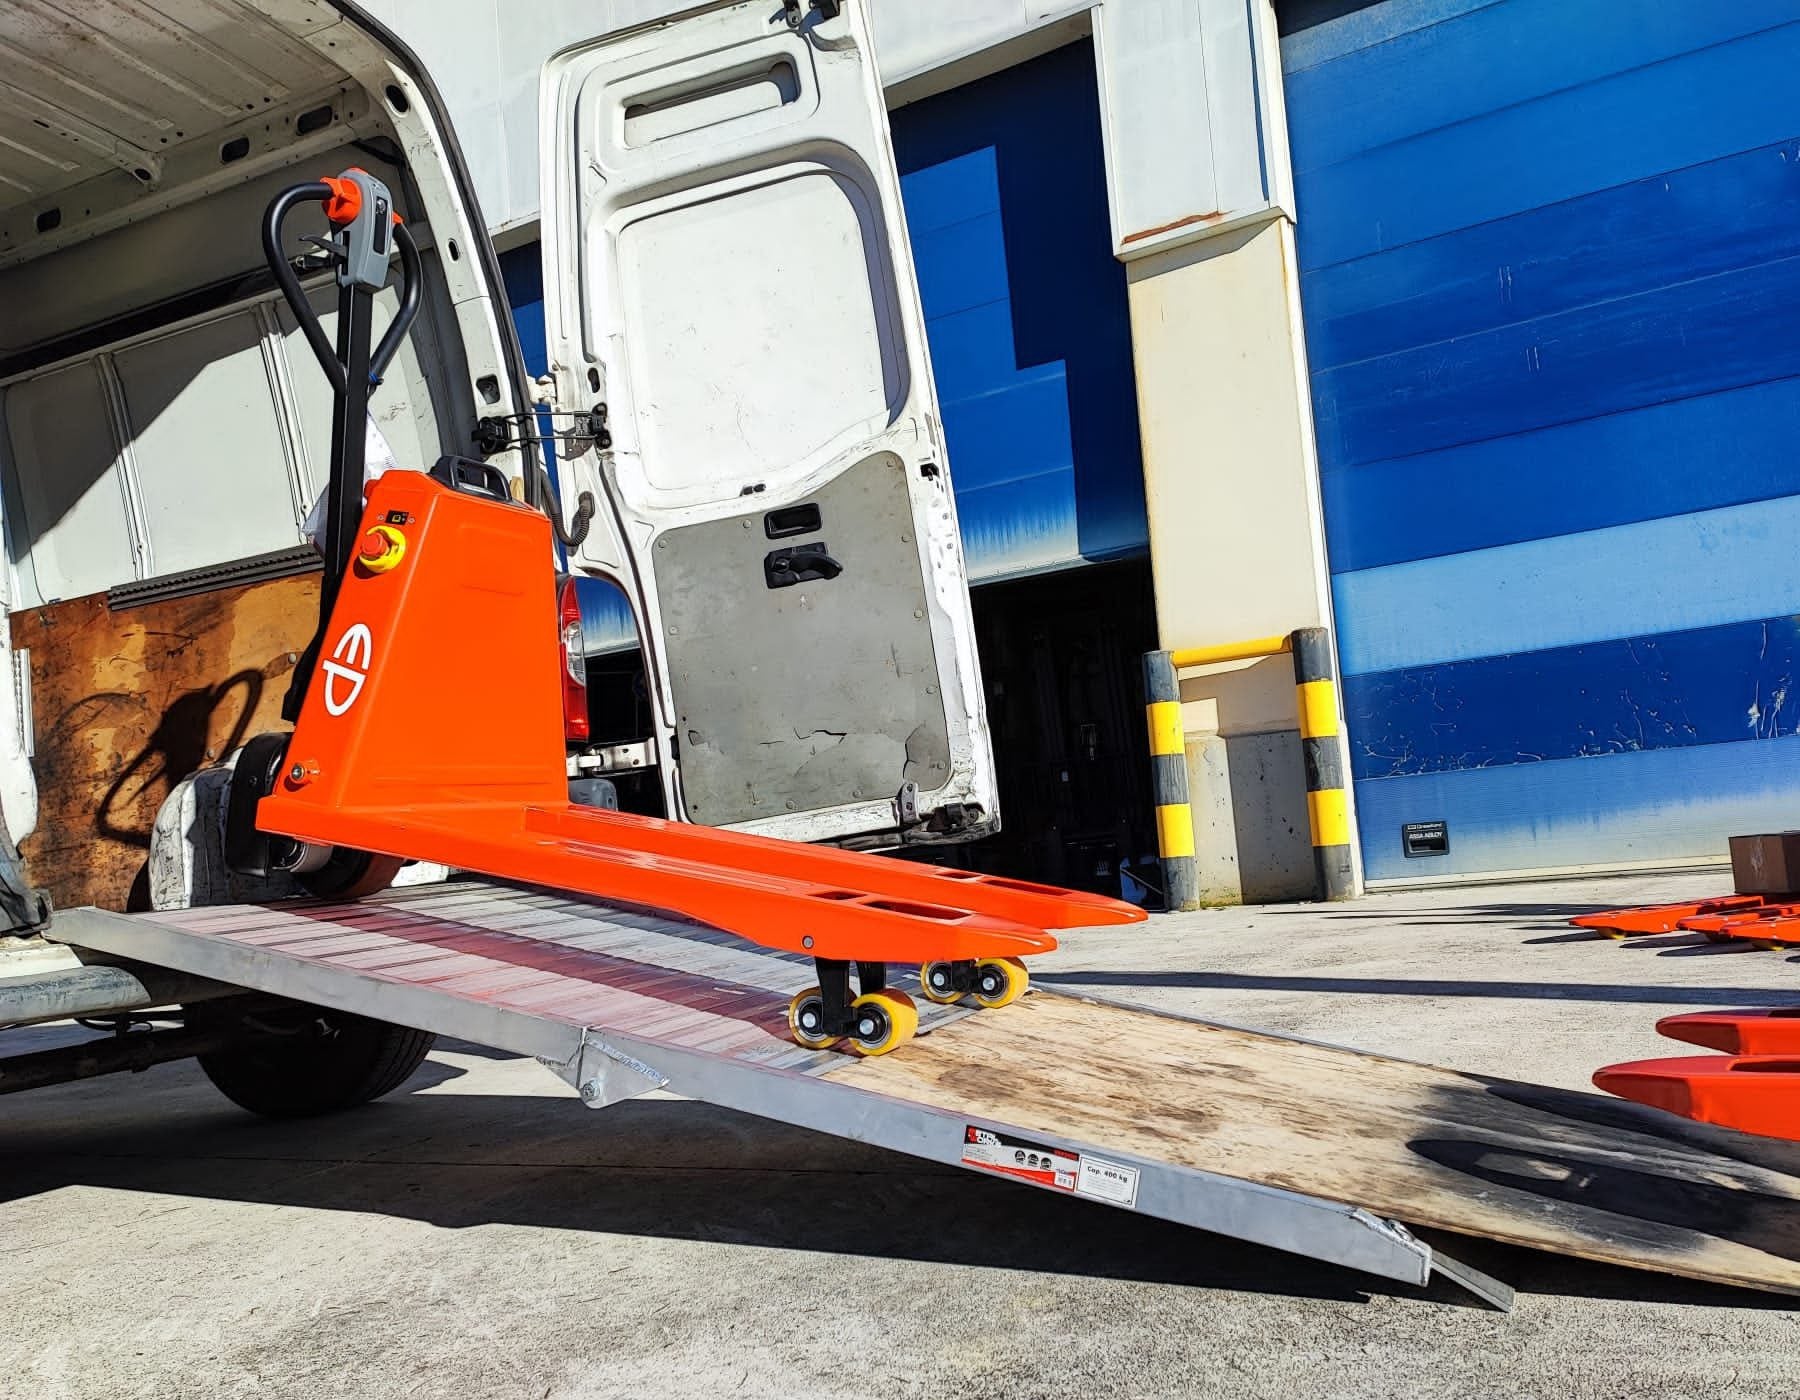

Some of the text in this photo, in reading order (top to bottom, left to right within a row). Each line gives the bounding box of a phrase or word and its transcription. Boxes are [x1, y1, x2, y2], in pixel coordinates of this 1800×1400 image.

[1087, 1166, 1128, 1183] Cap. 400 kg
